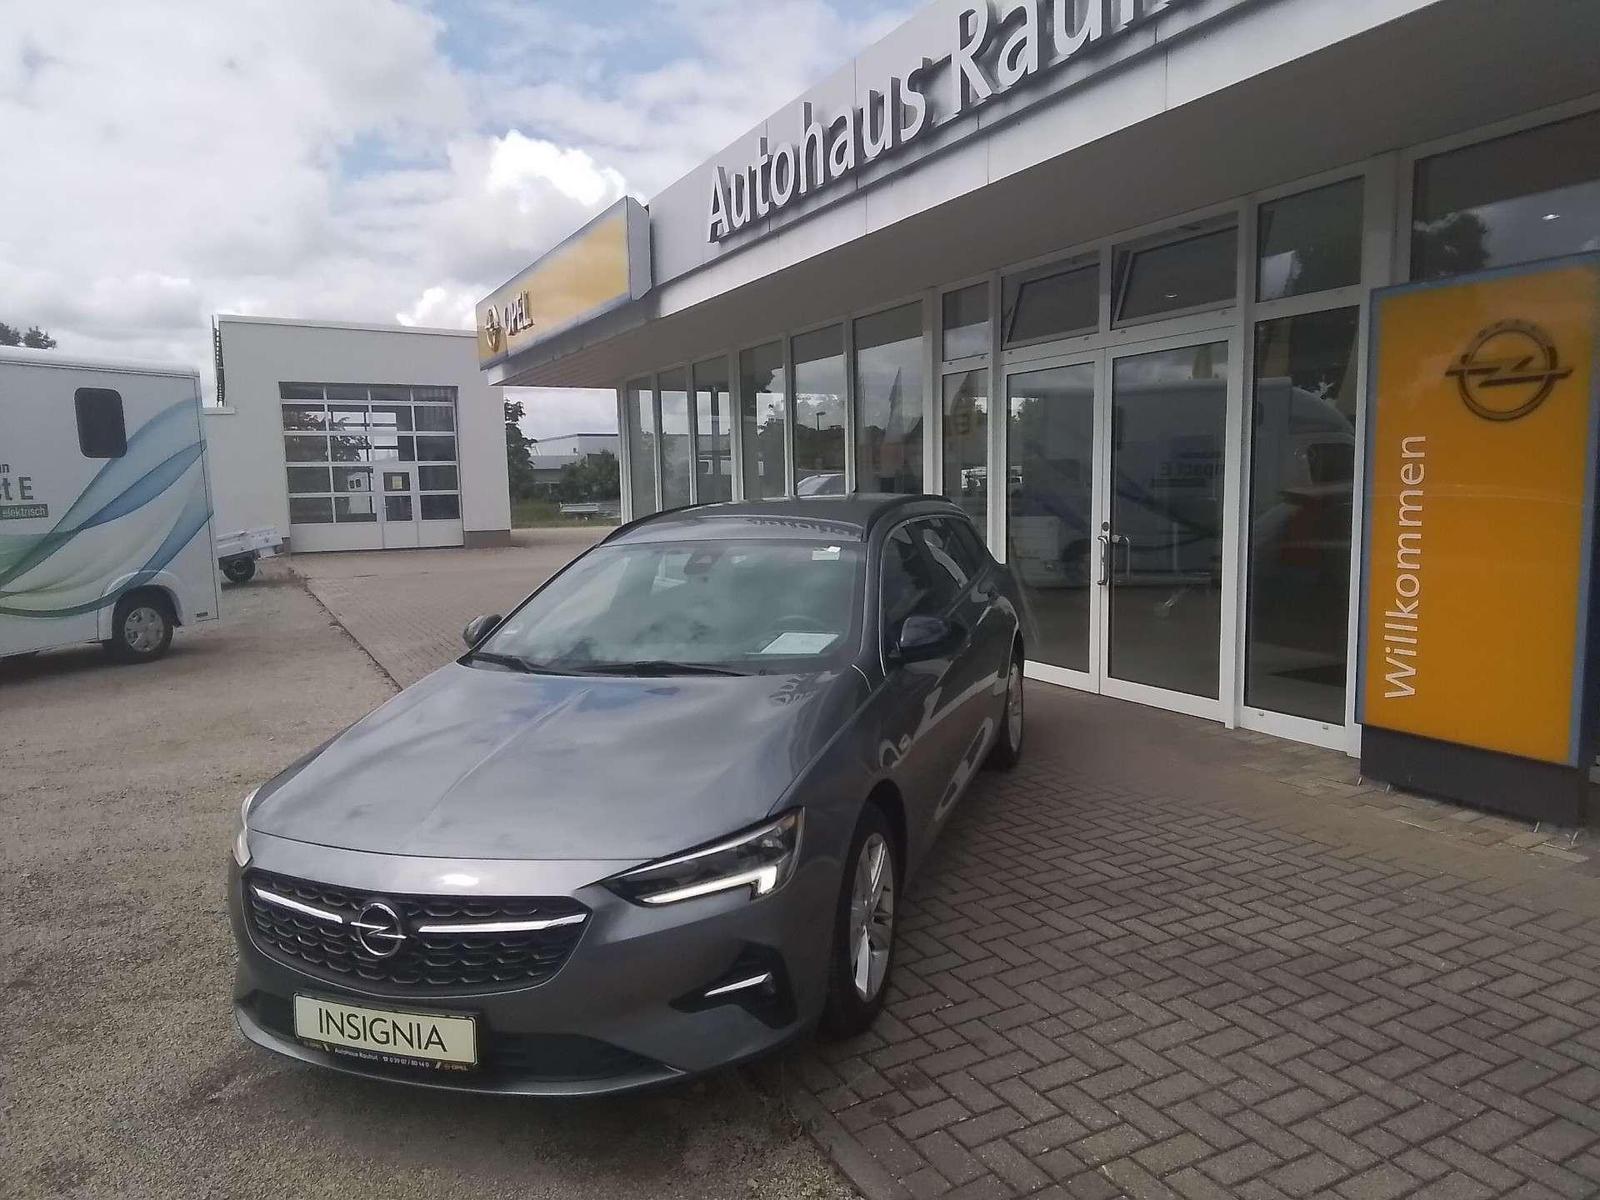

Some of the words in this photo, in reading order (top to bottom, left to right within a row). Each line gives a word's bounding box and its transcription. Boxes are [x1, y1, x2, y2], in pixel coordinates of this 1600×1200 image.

[707, 62, 928, 243] Autohaus
[504, 290, 534, 336] OPEL
[1384, 435, 1427, 699] Willkommen
[318, 1007, 448, 1052] INSIGNIA
